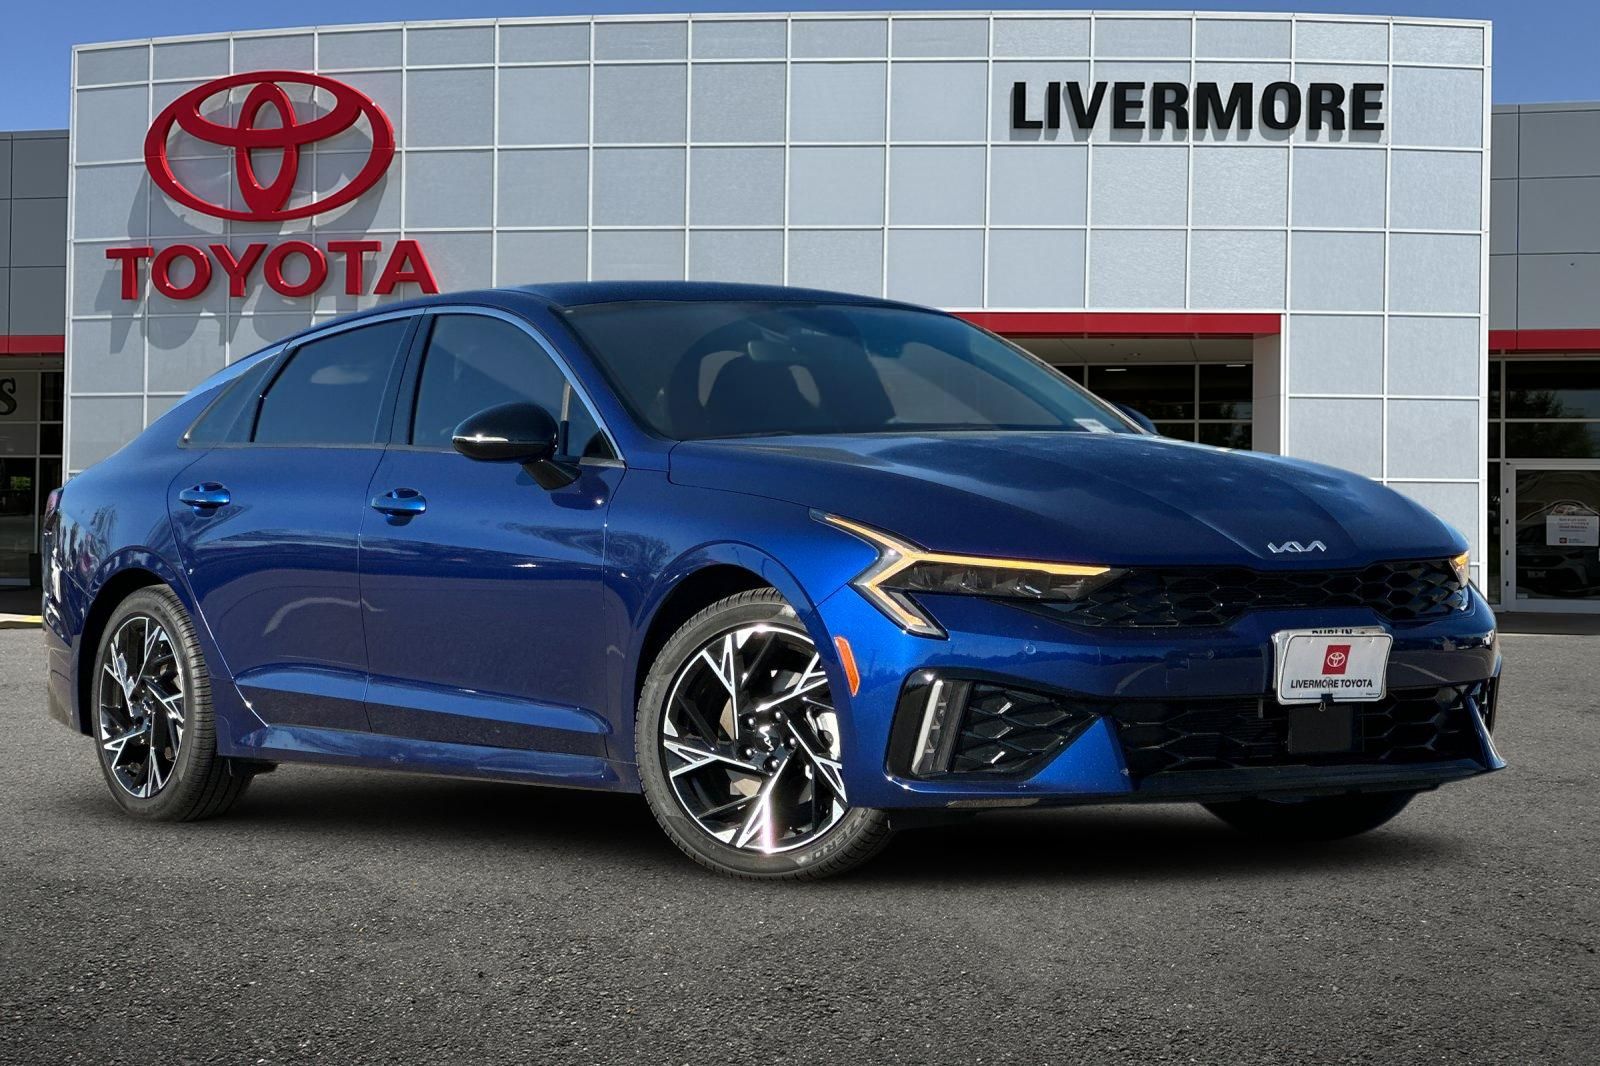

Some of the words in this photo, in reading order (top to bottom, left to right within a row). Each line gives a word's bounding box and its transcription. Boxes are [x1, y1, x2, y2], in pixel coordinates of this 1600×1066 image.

[1012, 81, 1385, 131] LIVERMORE
[105, 240, 440, 300] TOYOTA
[1291, 679, 1339, 689] LIVERMORE
[1340, 679, 1373, 688] TOYOTA
